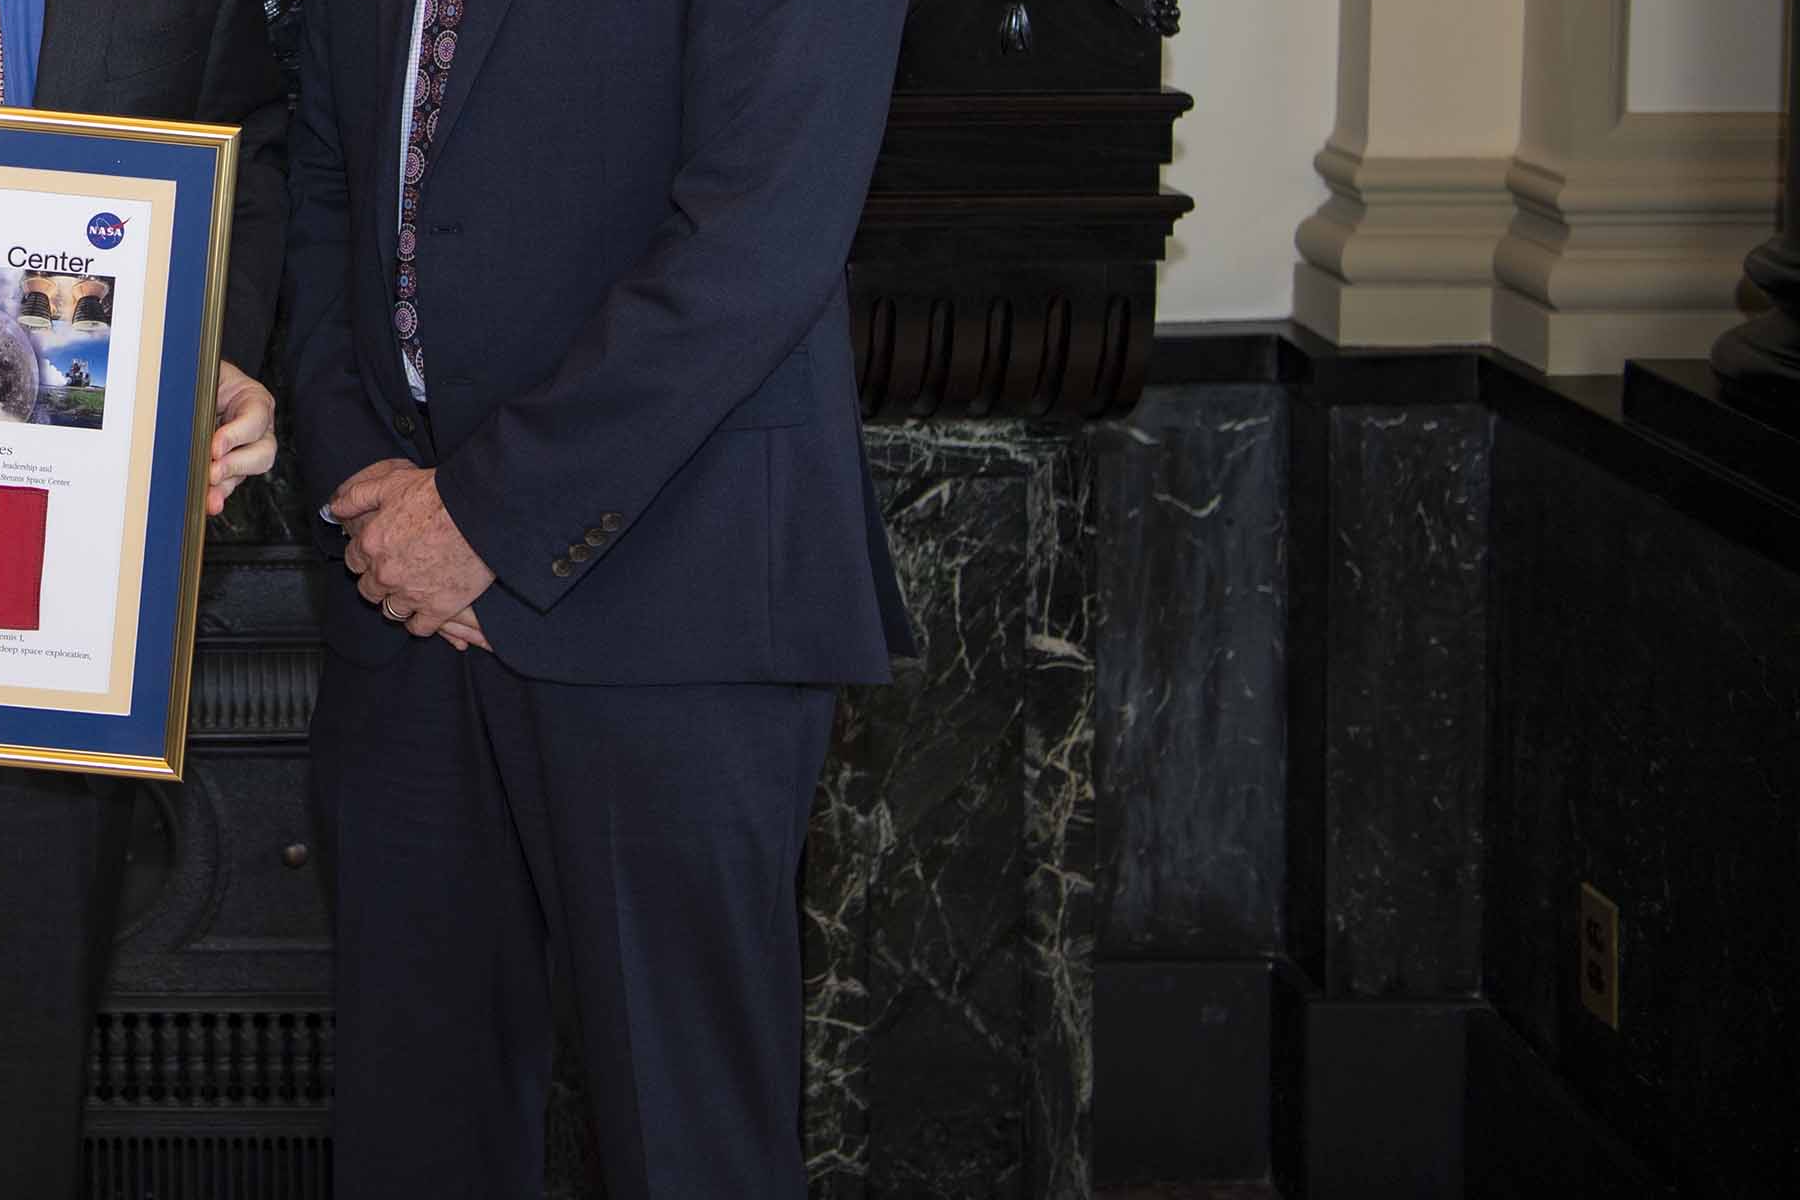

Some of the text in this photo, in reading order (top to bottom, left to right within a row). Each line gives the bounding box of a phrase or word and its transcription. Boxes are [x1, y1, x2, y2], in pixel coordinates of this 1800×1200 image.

[88, 225, 122, 238] NASA
[7, 246, 94, 273] Center
[2, 462, 38, 473] leadership
[39, 465, 52, 473] and
[0, 644, 19, 655] deep
[21, 647, 43, 656] space
